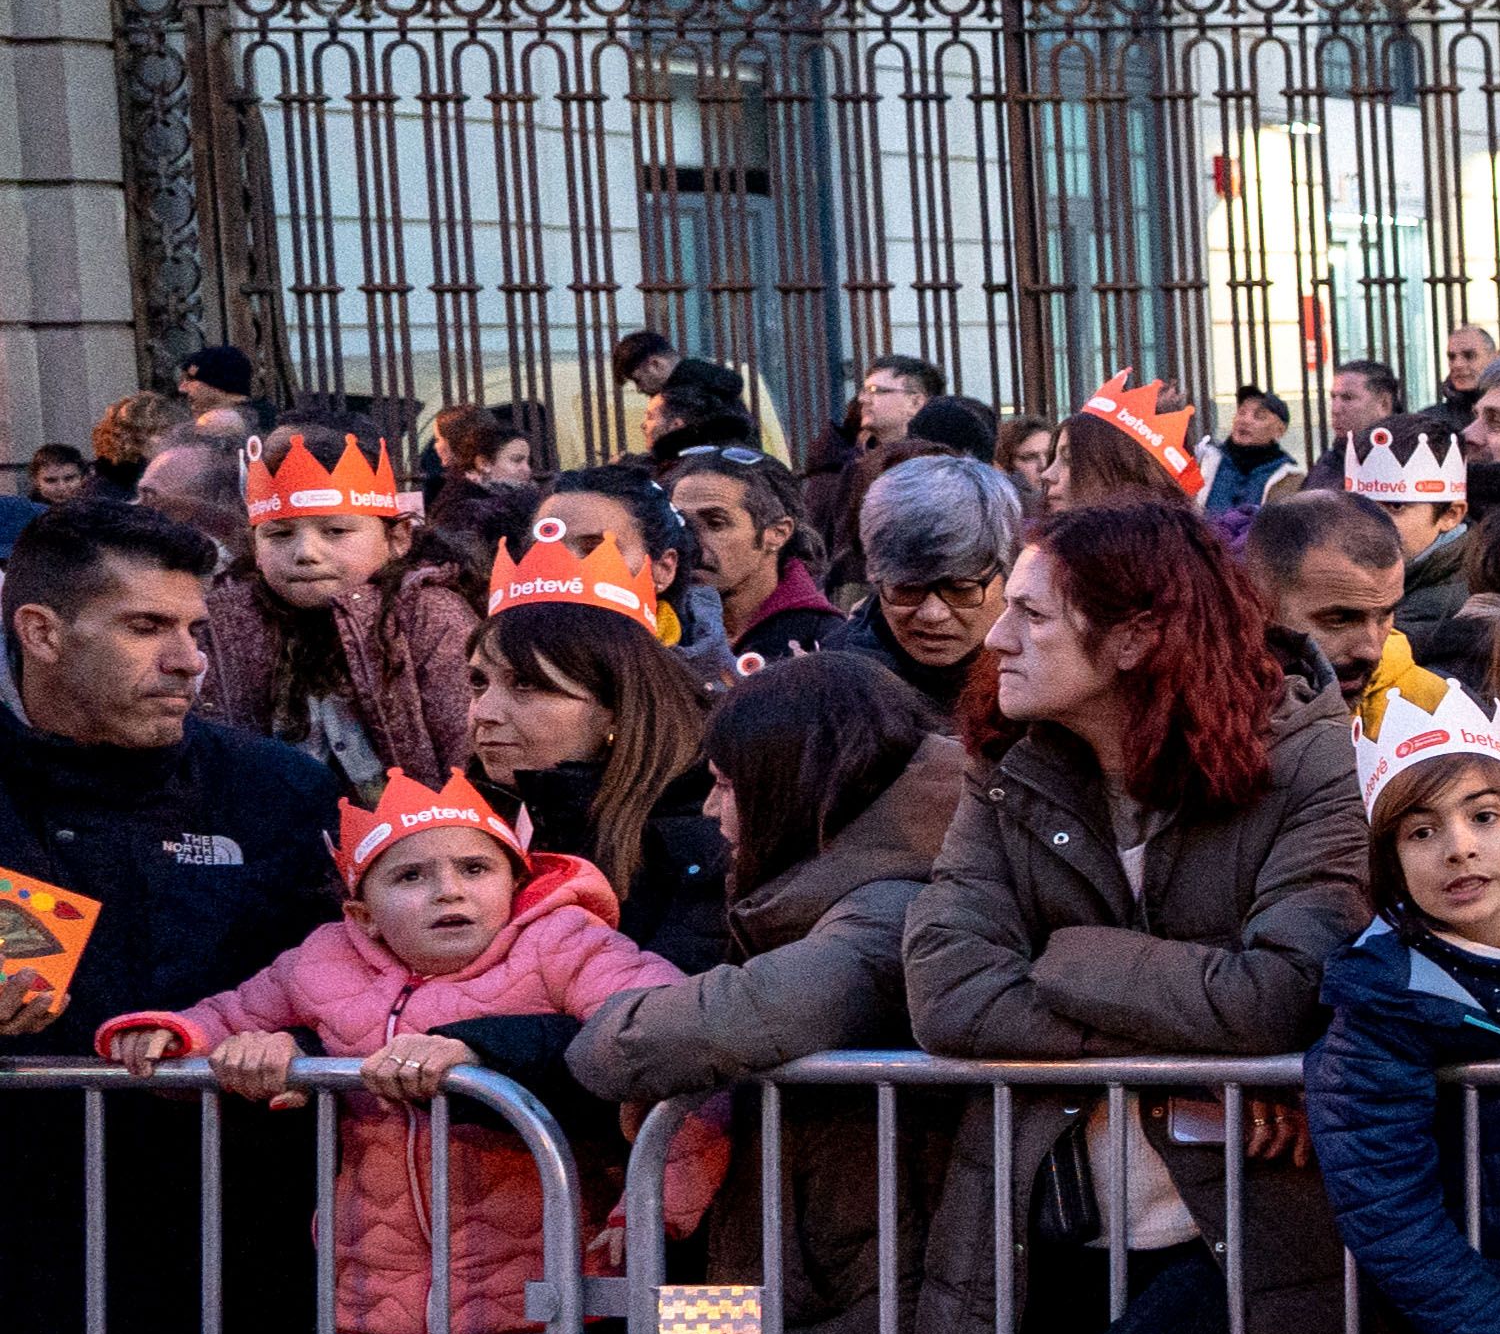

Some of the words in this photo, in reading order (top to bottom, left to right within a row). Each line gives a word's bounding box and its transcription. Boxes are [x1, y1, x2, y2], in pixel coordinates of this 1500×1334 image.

[1115, 409, 1161, 447] betevé
[1356, 478, 1407, 493] betevé
[348, 489, 396, 509] betevé
[509, 577, 583, 599] betevé
[400, 806, 481, 828] betevé
[162, 840, 212, 855] NORTH
[182, 833, 211, 846] THE
[177, 852, 213, 866] FACE
